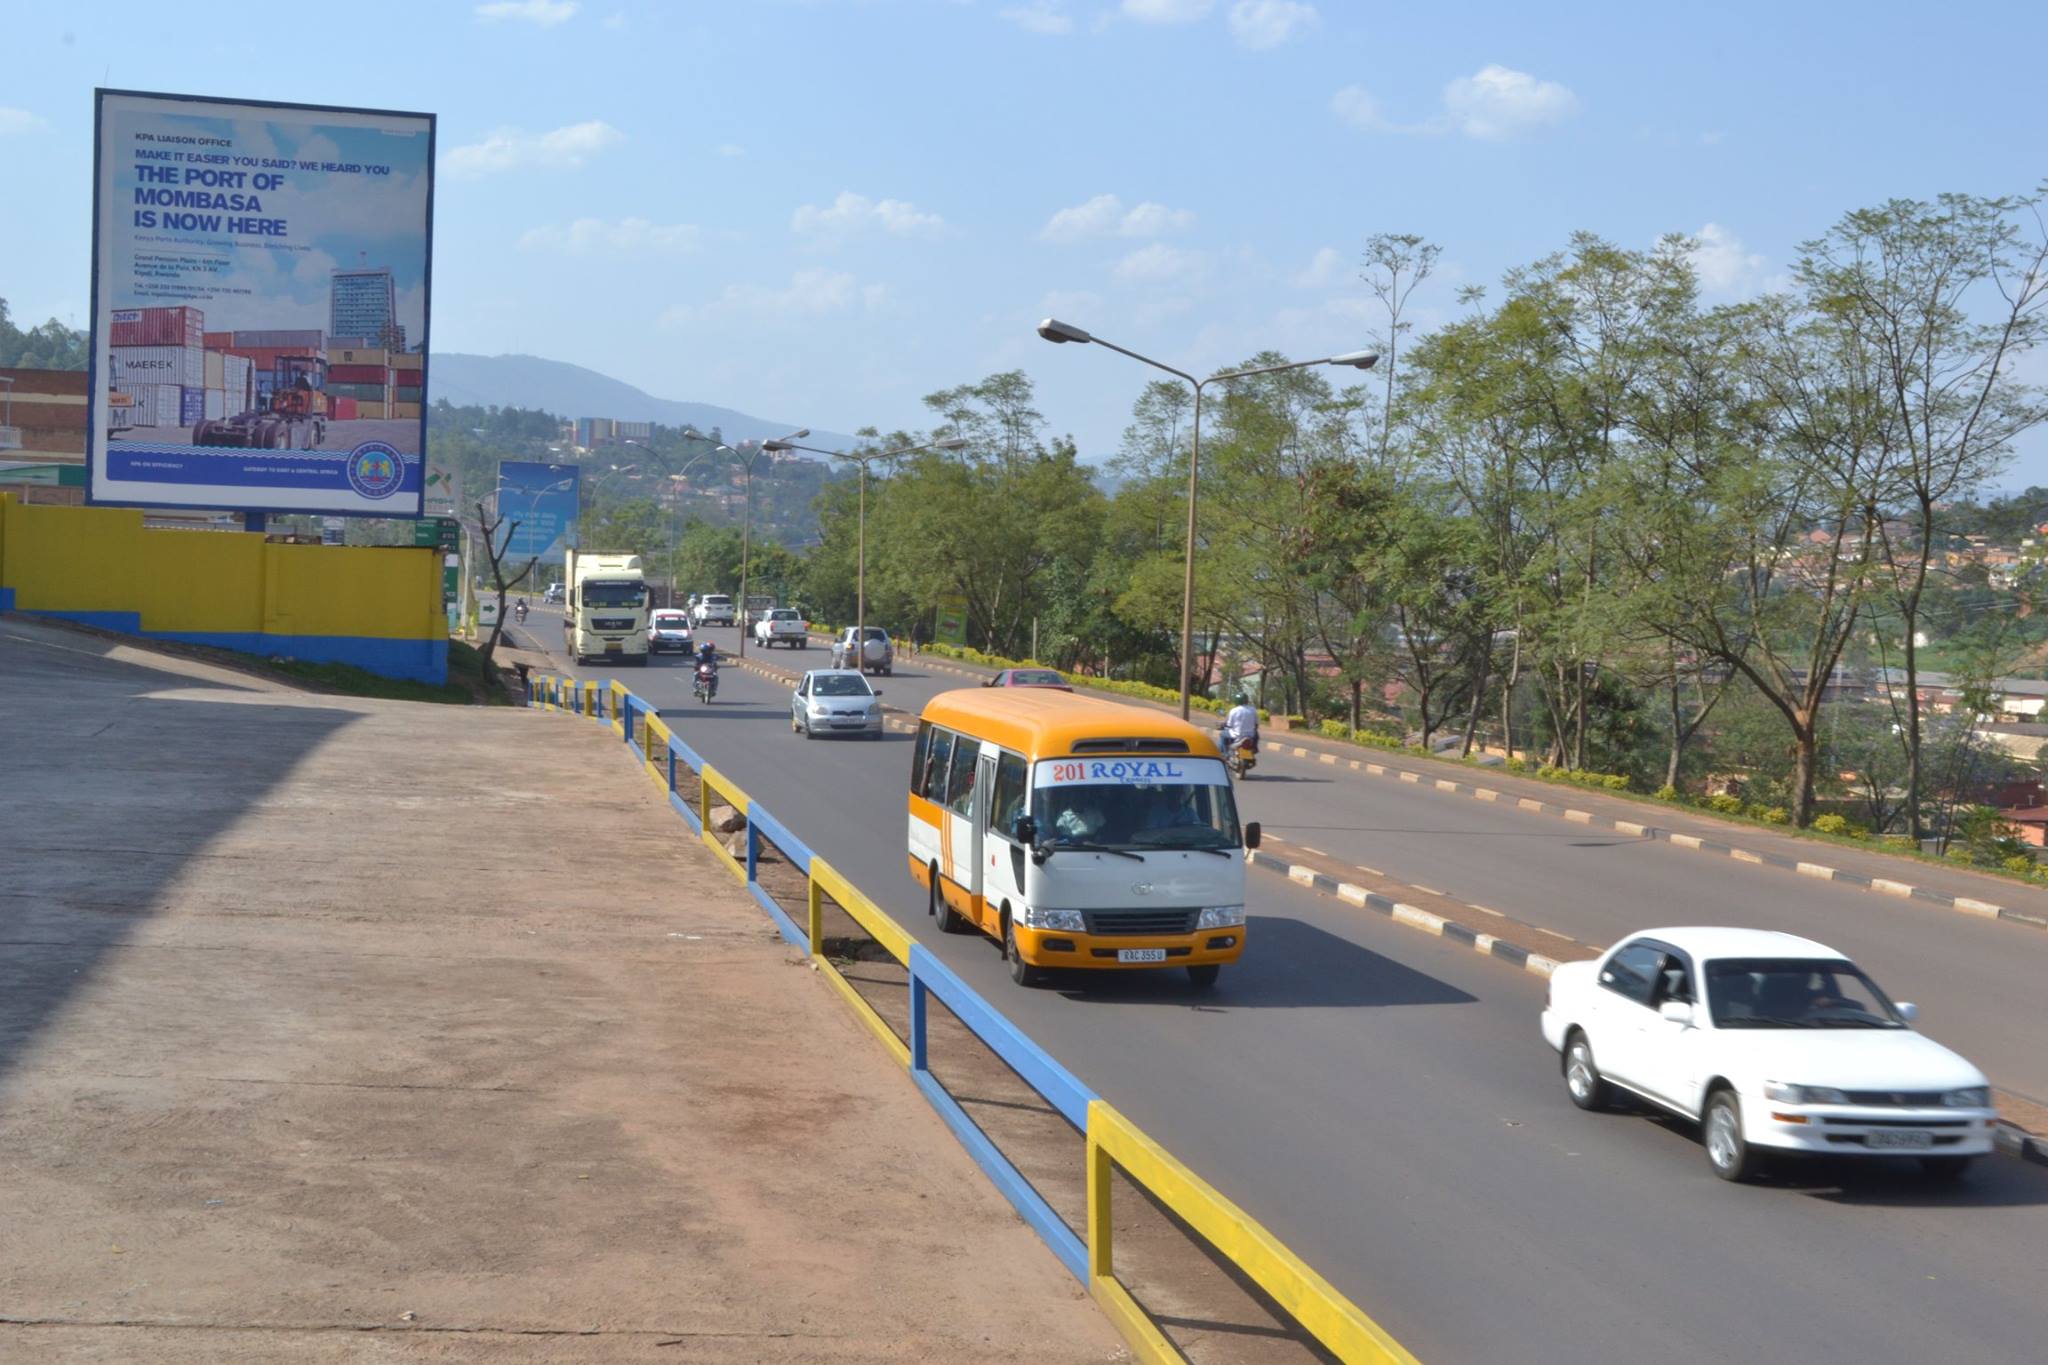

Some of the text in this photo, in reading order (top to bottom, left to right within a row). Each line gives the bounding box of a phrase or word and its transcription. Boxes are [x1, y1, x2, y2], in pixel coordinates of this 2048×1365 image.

[135, 133, 232, 148] KPA LIAISON OFFICE
[135, 149, 390, 176] MAKE IT EASIER YOU SAID? WE HEARD YOU
[134, 165, 285, 191] THE PORT OF
[134, 187, 262, 213] MOMBASA
[134, 211, 287, 237] IS NOW HERE
[1053, 762, 1183, 782] 201 ROYAL
